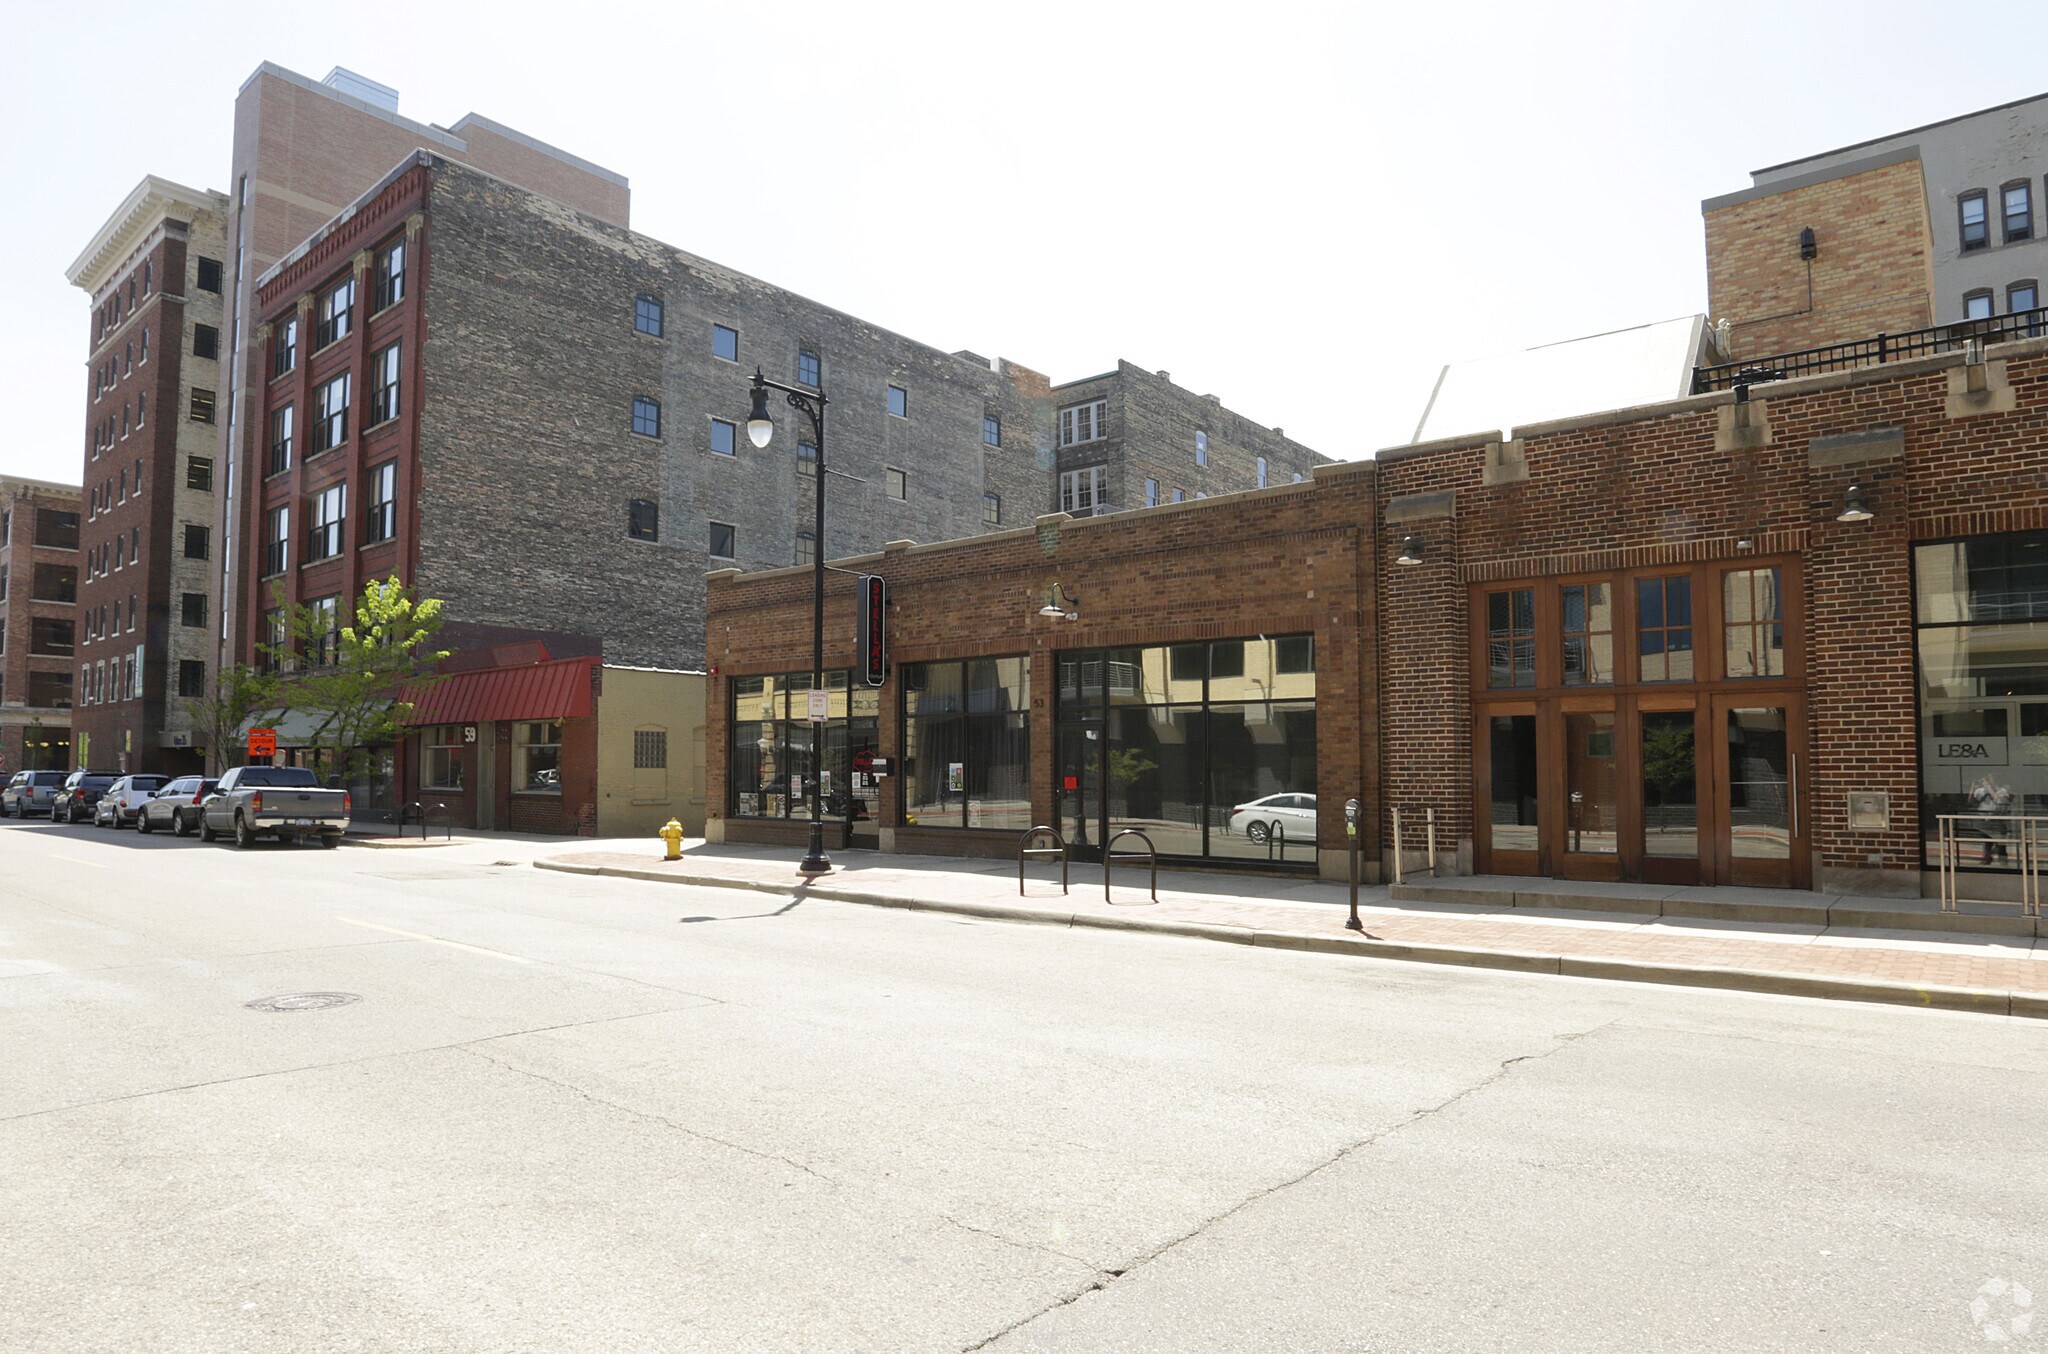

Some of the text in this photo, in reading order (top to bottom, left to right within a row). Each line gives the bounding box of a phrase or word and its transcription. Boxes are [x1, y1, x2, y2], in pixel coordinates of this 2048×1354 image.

[1034, 699, 1044, 708] 53
[465, 727, 475, 742] 59
[1938, 744, 1989, 758] LE&A
